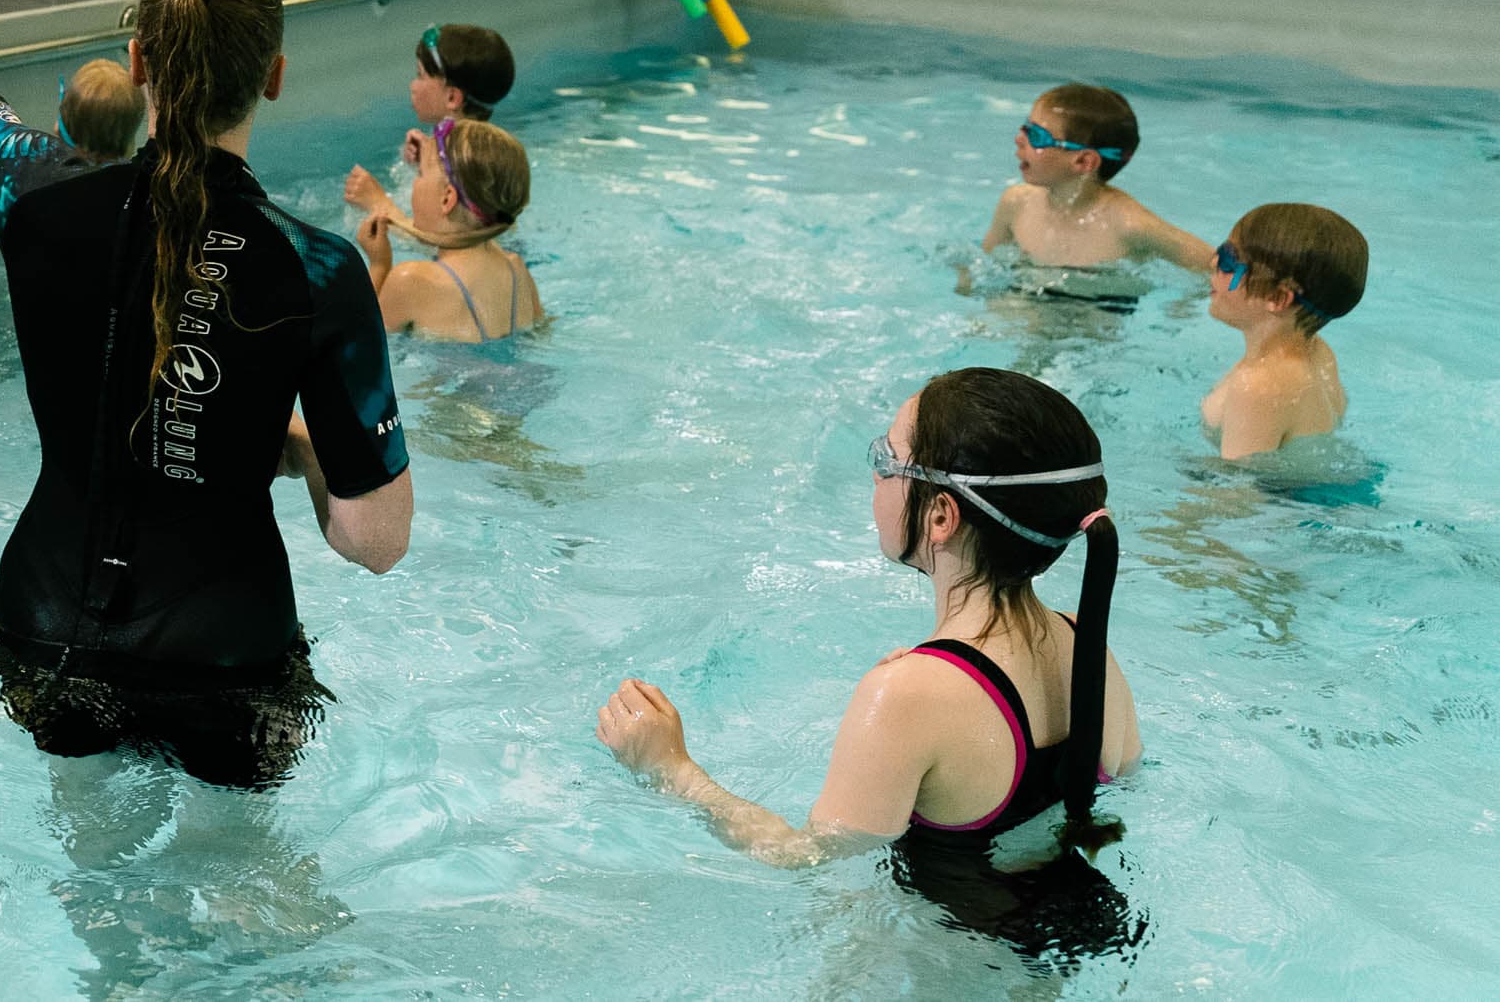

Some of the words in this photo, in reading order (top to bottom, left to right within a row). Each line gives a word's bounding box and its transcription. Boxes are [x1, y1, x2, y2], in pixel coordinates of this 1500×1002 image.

[177, 230, 246, 335] AQUA
[152, 398, 160, 433] DESIGNED
[163, 397, 203, 480] LUNG
